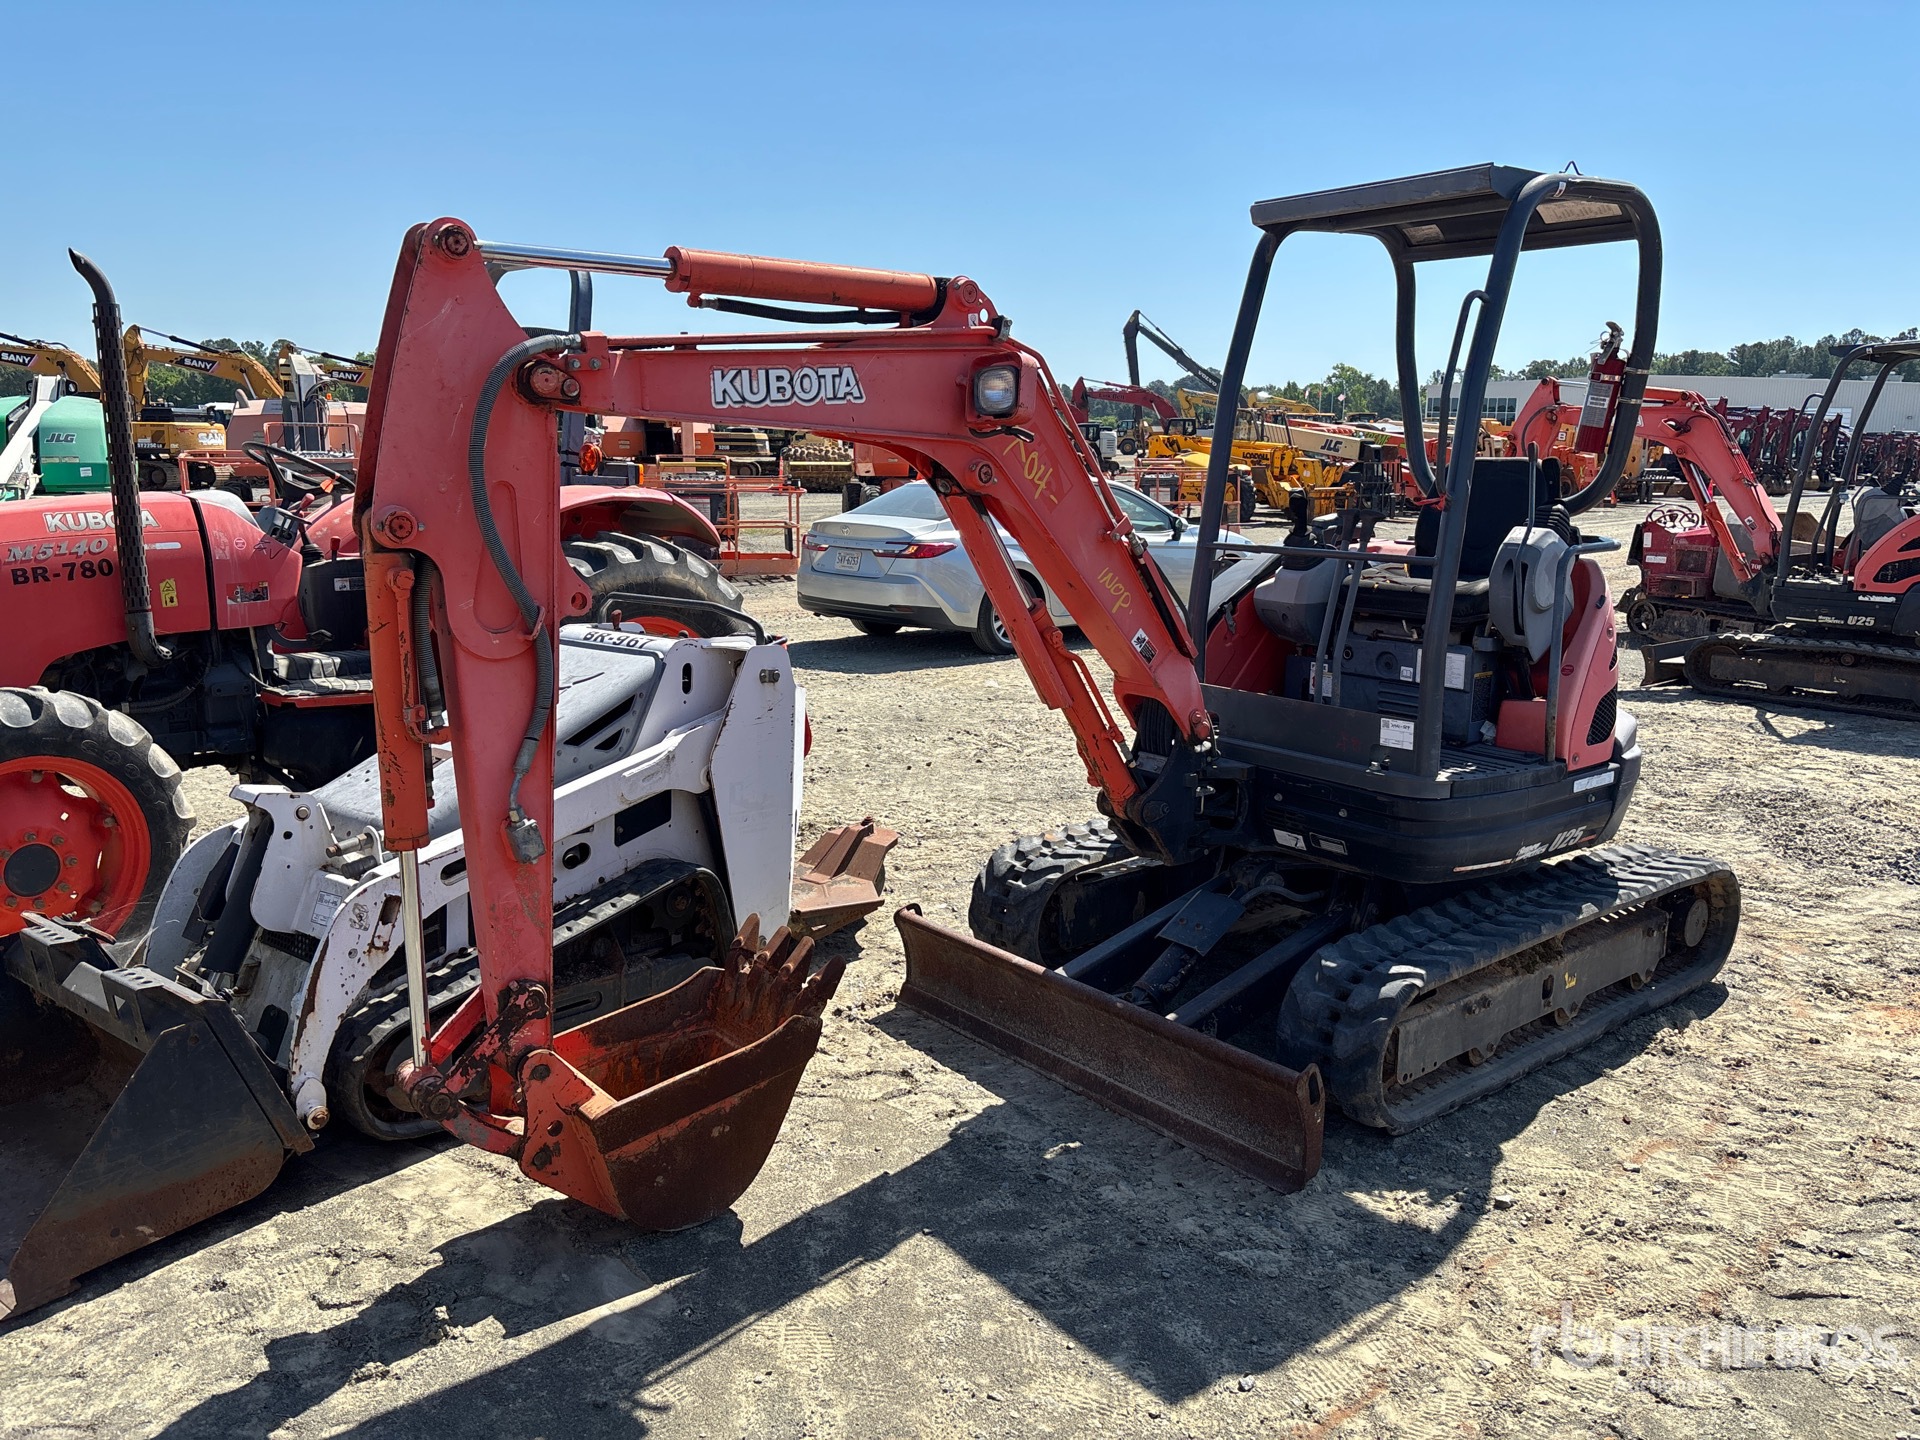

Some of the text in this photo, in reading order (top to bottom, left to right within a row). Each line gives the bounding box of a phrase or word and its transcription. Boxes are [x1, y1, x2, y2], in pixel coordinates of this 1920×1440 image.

[1, 352, 31, 364] SANY
[183, 357, 214, 370] SANY
[332, 371, 359, 381] SANY
[1197, 370, 1219, 387] VOLVO
[712, 366, 865, 405] KUBOTA
[44, 432, 77, 443] JLG
[1320, 438, 1343, 453] JLG
[1242, 451, 1270, 461] LOADALL
[5, 537, 109, 564] M5140
[11, 558, 114, 585] BR-780
[1847, 615, 1876, 627] U25
[583, 631, 656, 649] BR-967
[1547, 825, 1588, 852] U25
